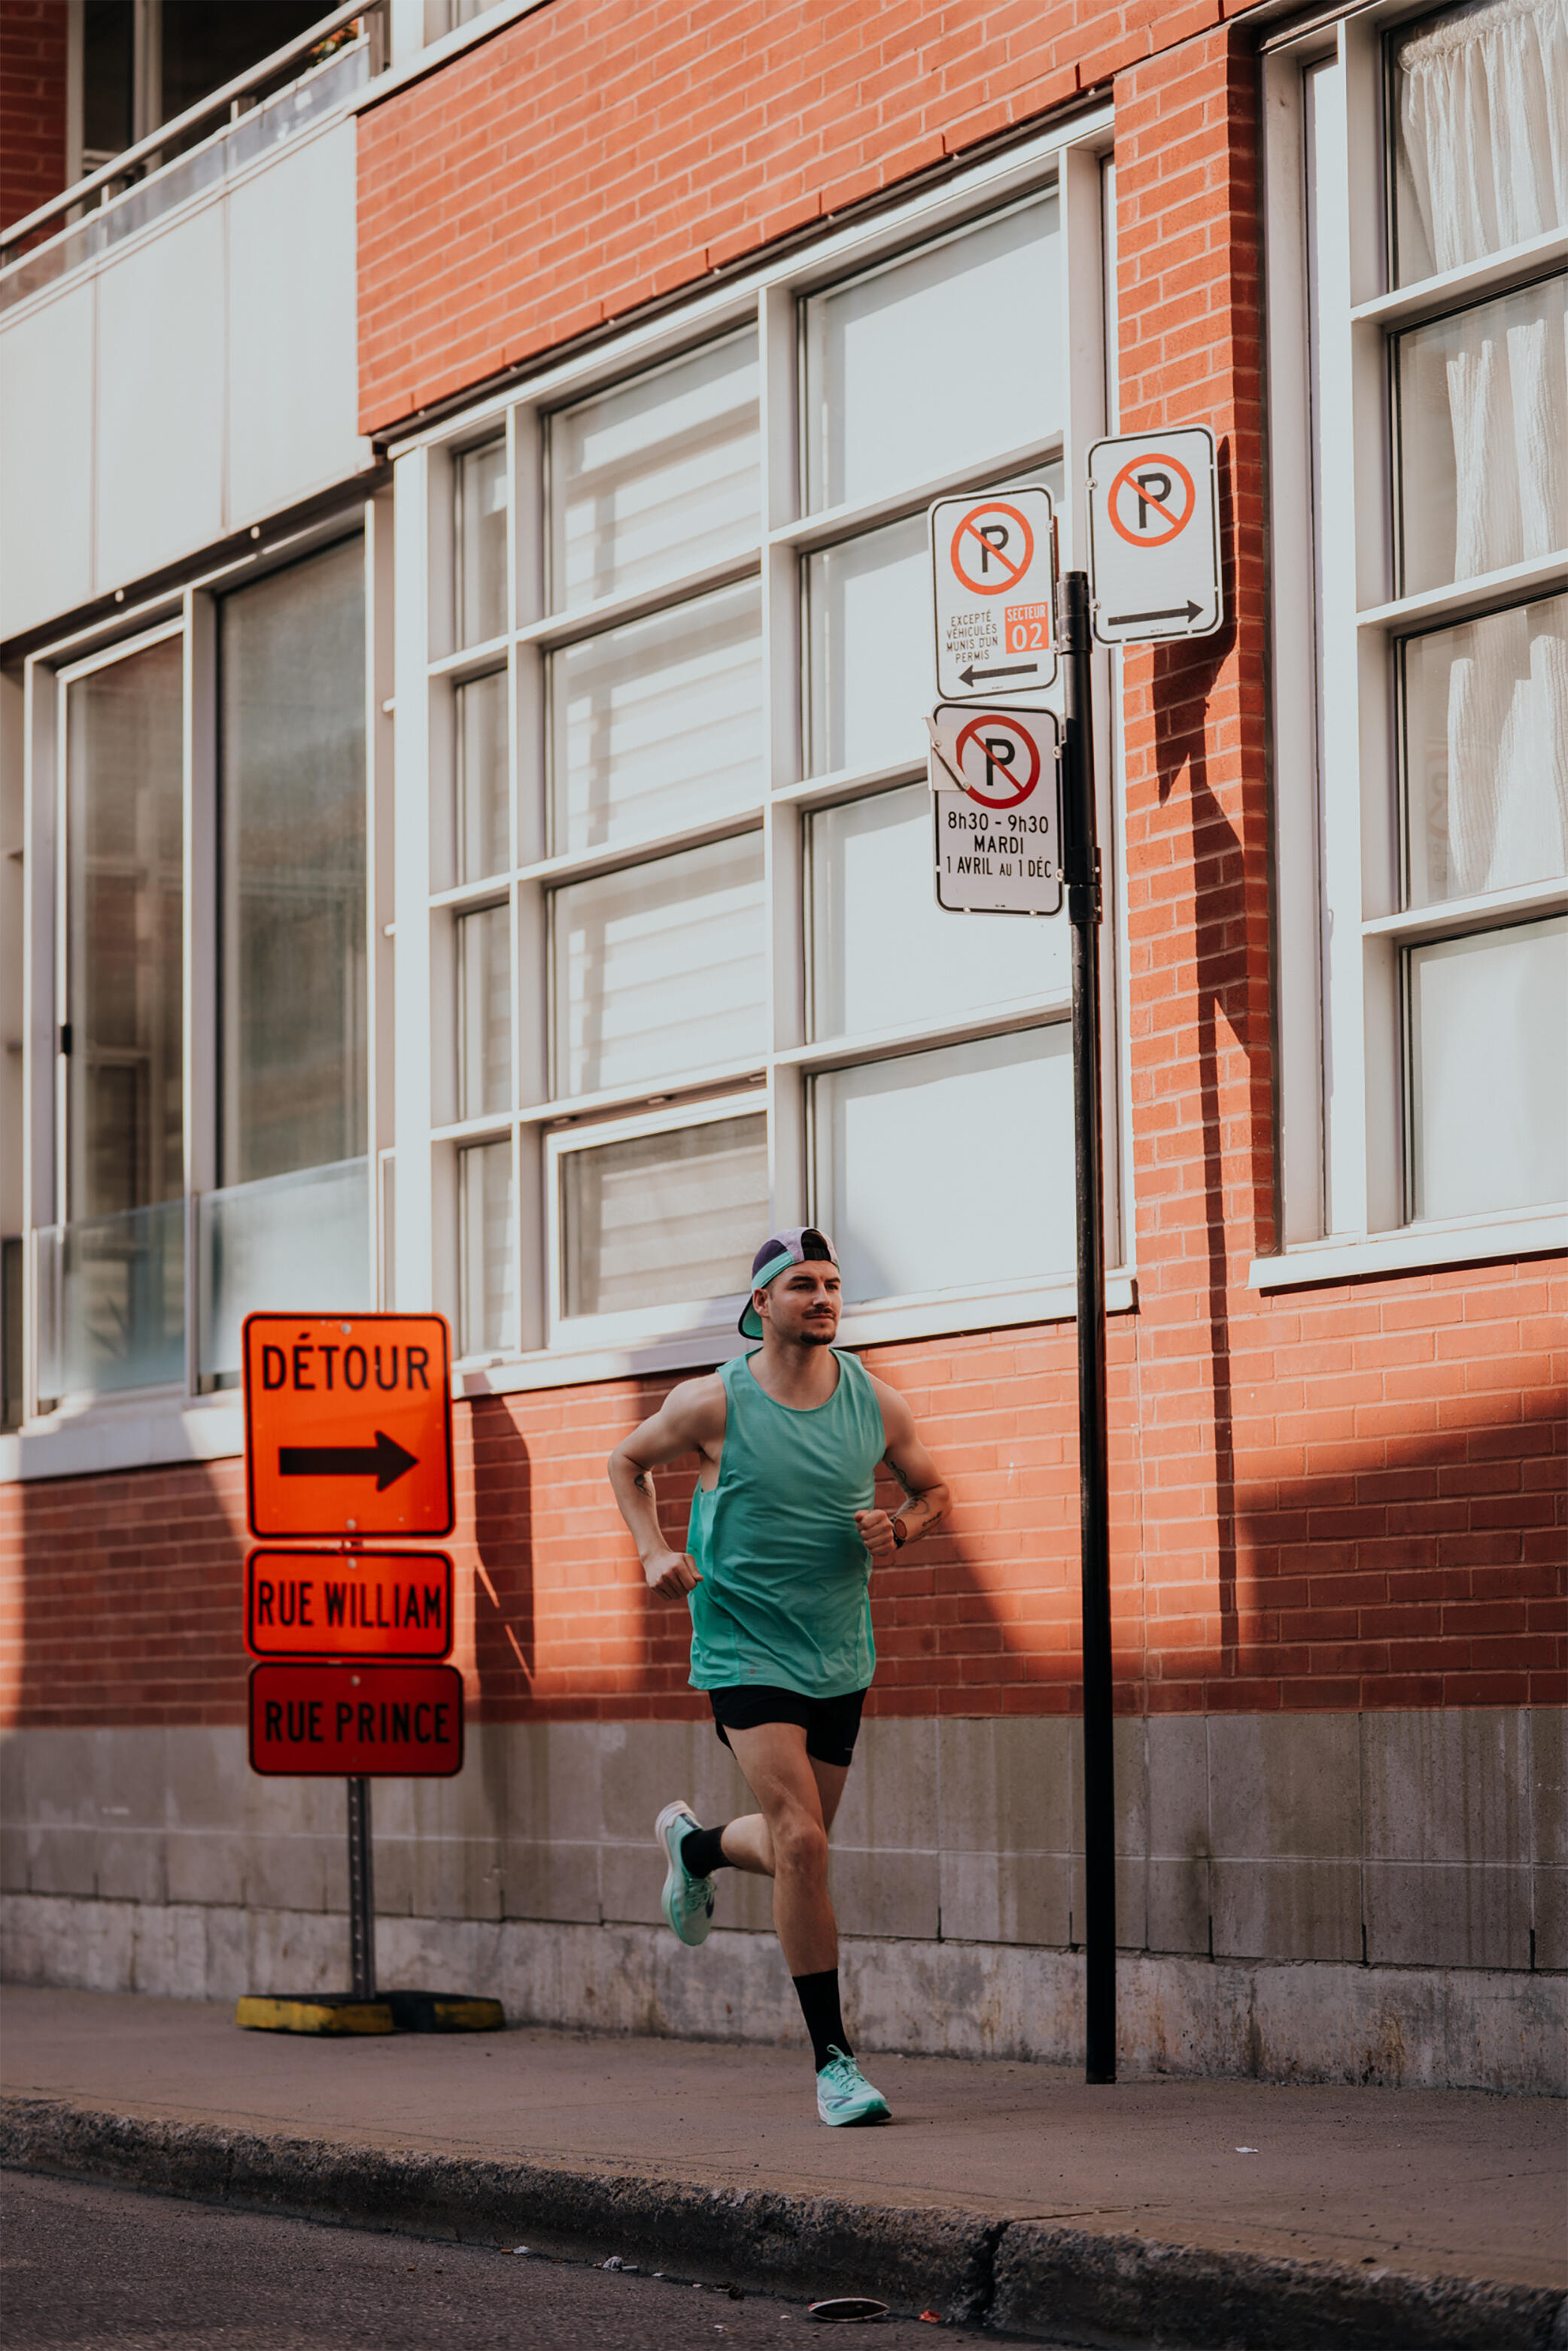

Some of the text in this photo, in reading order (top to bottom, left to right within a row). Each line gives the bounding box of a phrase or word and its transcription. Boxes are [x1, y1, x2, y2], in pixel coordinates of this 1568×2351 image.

[951, 609, 992, 627] EXCEPTÉ
[1007, 604, 1046, 622] SECTEUR
[947, 623, 998, 639] VÉHICULES
[1012, 623, 1043, 651] 02
[947, 639, 975, 652] MUNIS
[956, 649, 990, 663] PERMIS
[948, 811, 989, 831] 8h30
[1007, 814, 1049, 834] 9h30
[974, 835, 1023, 854] MARDI
[947, 855, 1051, 878] 1 AVRIL AU 1 DÉC
[263, 1332, 430, 1391] DÉTOUR
[259, 1581, 442, 1630] RUE WILLIAM
[266, 1700, 451, 1744] RUE PRINCE
